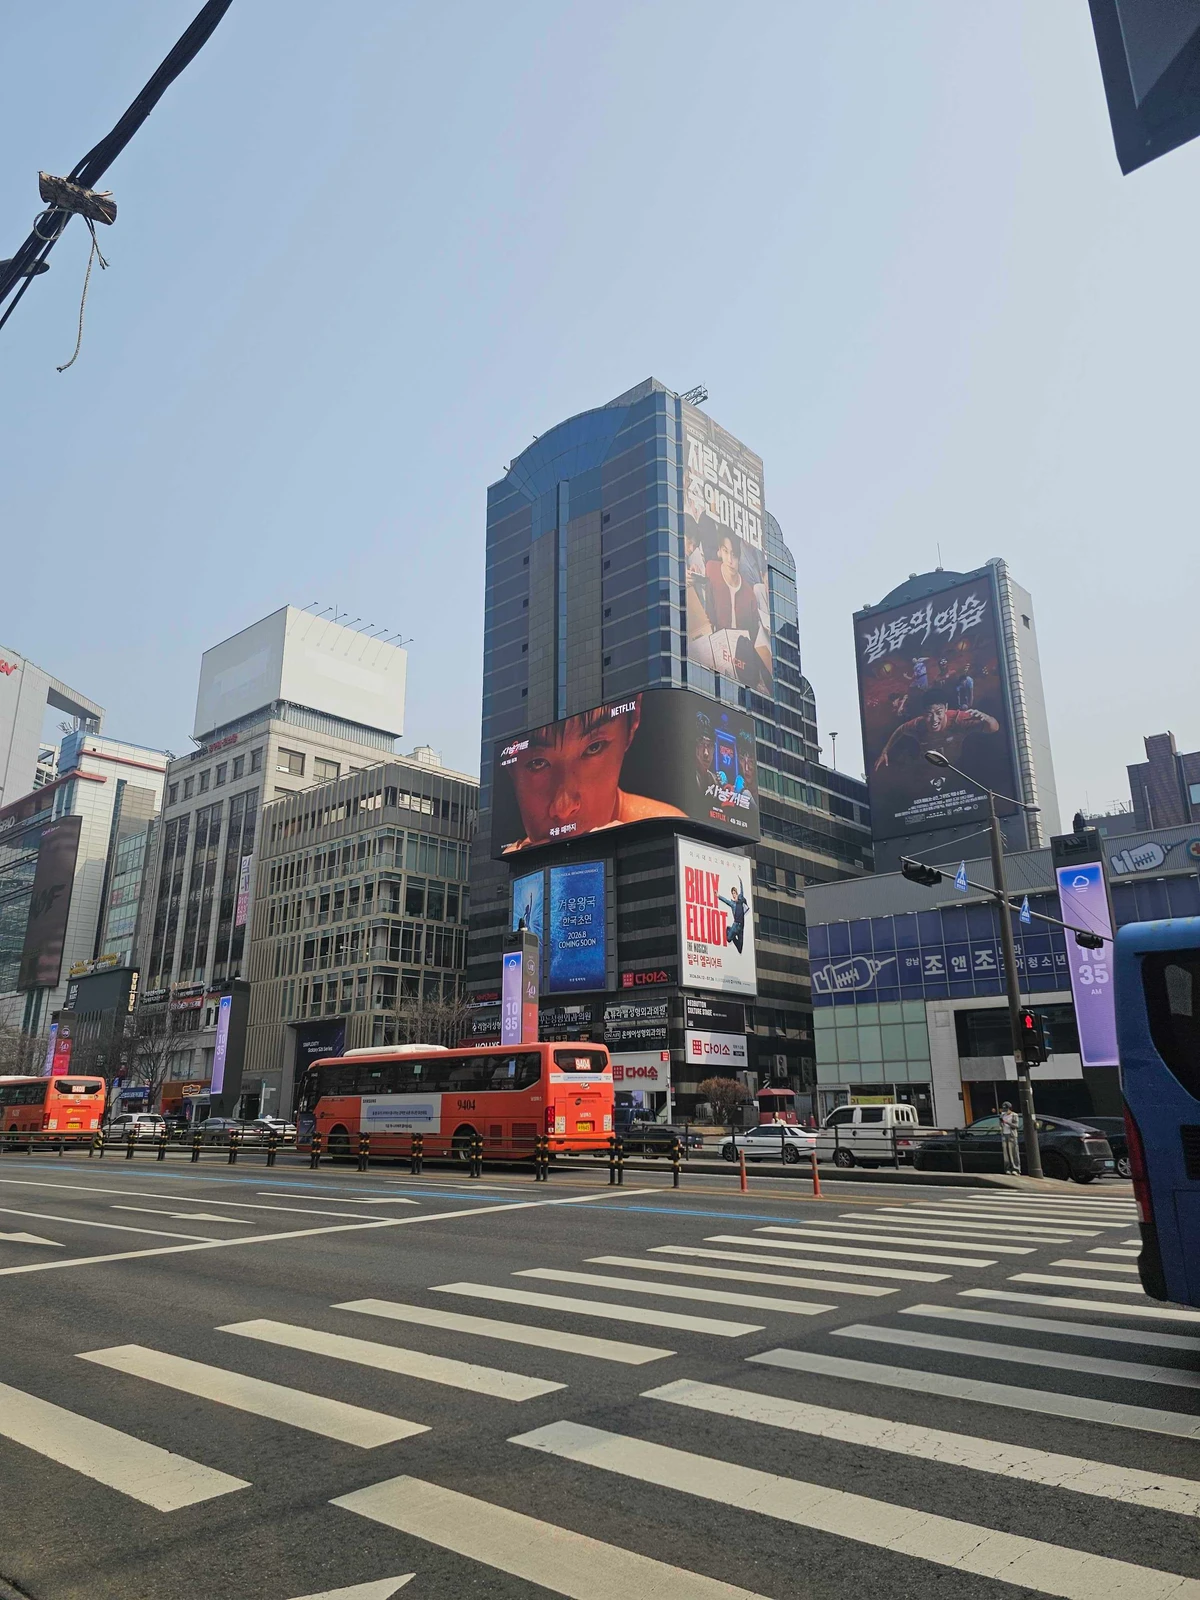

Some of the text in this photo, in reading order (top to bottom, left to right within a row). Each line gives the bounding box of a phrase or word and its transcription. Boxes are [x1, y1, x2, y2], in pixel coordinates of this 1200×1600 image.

[686, 434, 762, 516] 자랑스러운
[688, 472, 763, 551] 주인이돼라
[863, 593, 988, 664] 발톱의 역습
[611, 701, 636, 717] NETFLIX
[709, 810, 727, 822] NETFLIX
[549, 826, 560, 836] 죽을
[684, 865, 720, 909] BILLY
[559, 895, 596, 913] 겨울왕국
[561, 913, 592, 928] 한국초연
[685, 903, 728, 947] ELLIOT
[567, 931, 587, 940] 2026.8
[558, 937, 597, 950] COMING SOON
[686, 953, 699, 967] 빌리
[905, 957, 920, 967] 강남
[635, 970, 669, 984] 다이소
[1079, 963, 1110, 985] 35
[505, 1002, 518, 1016] 10
[687, 1007, 702, 1015] CULTURE
[702, 1009, 713, 1017] STAGE
[505, 1017, 518, 1030] 35
[217, 1034, 226, 1043] 10
[216, 1046, 225, 1055] 35
[703, 1043, 731, 1055] 다이소
[575, 1058, 591, 1070] 9404
[625, 1066, 658, 1079] 다이소
[457, 1099, 476, 1110] 9404
